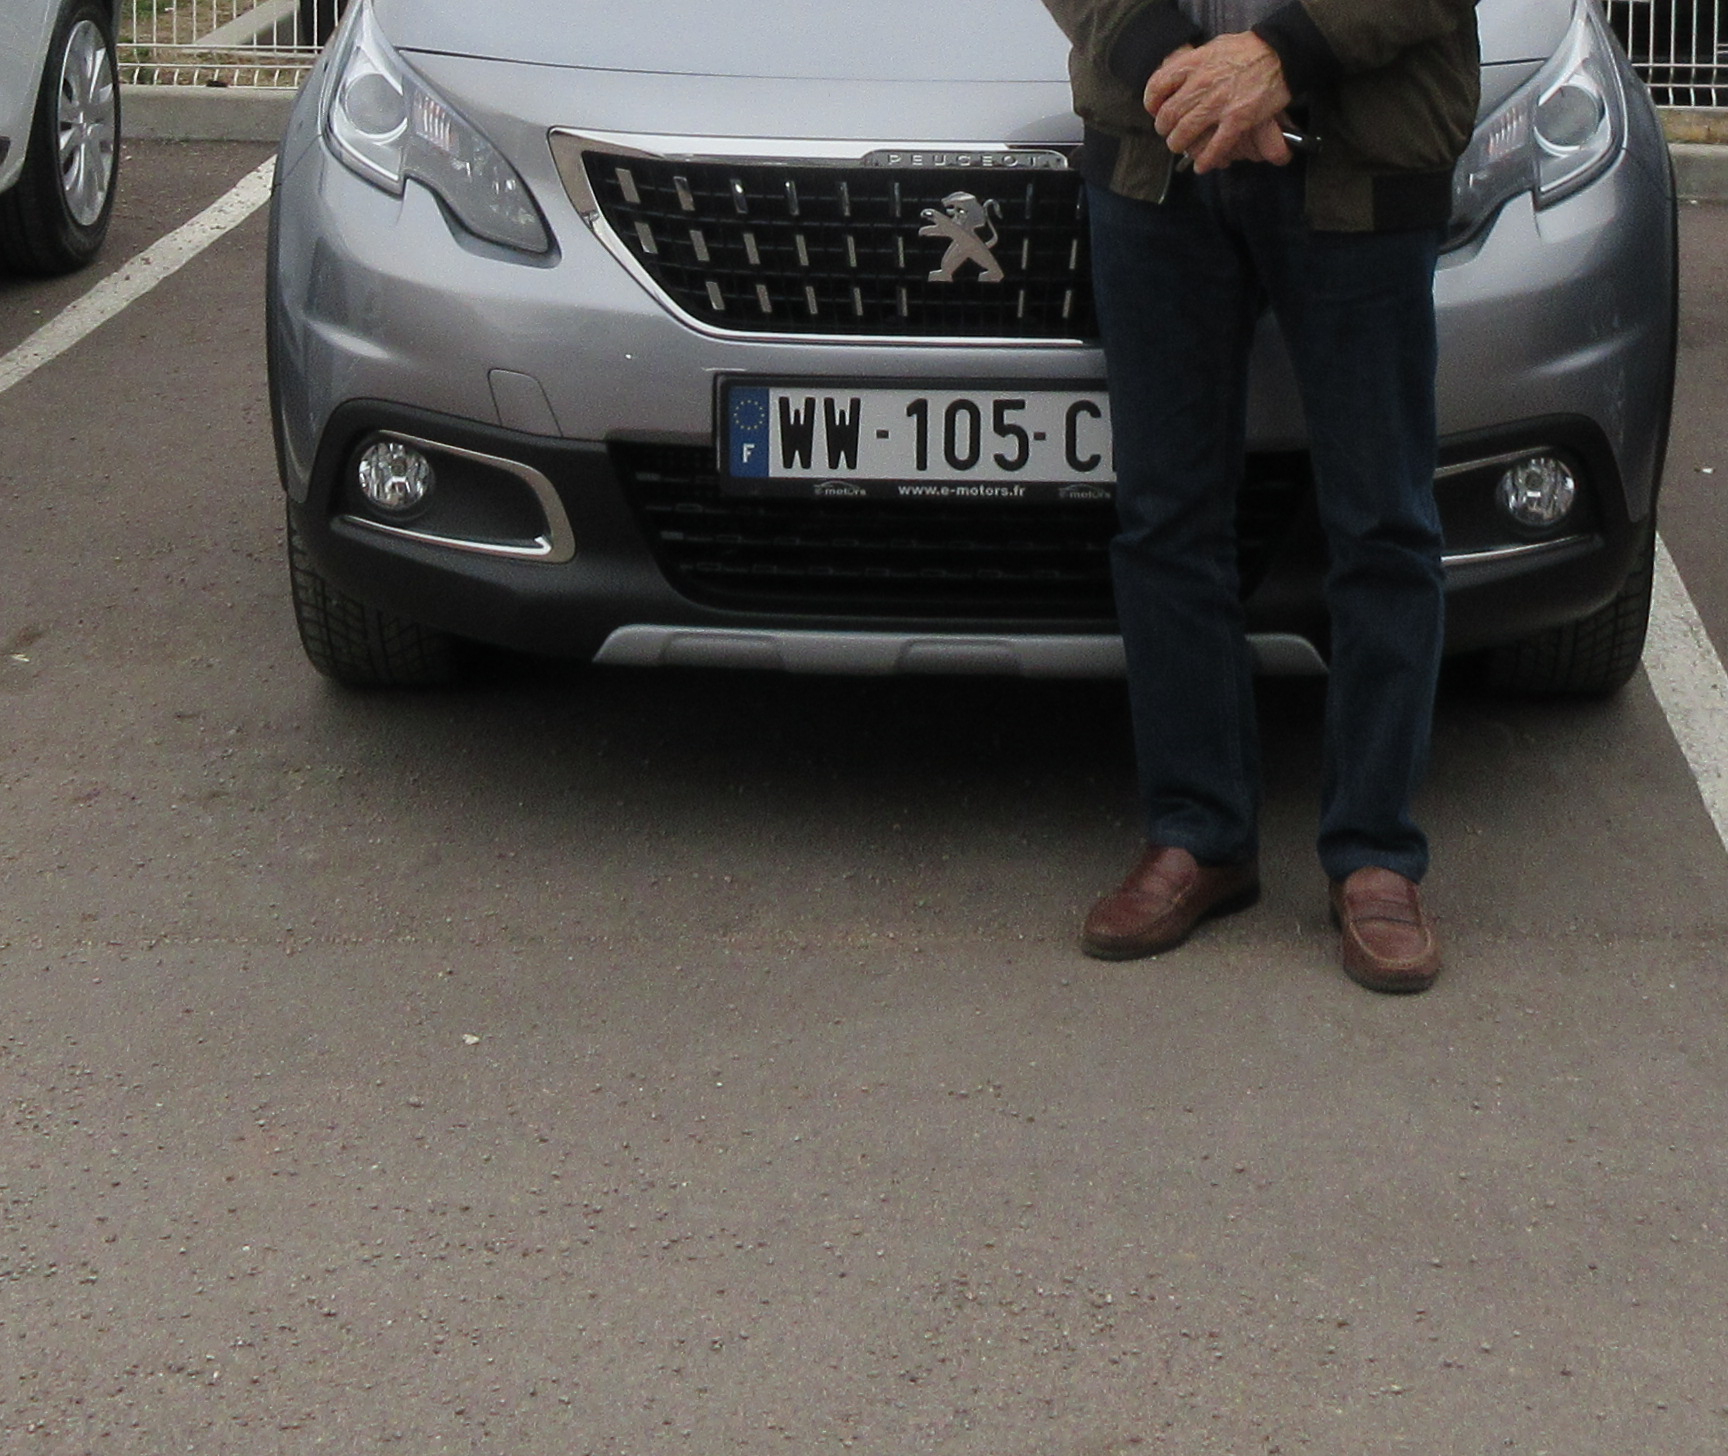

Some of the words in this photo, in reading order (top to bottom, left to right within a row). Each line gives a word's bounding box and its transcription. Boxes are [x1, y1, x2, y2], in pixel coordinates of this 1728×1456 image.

[887, 153, 1042, 168] PEUGEOT
[742, 443, 755, 464] F
[778, 396, 1117, 473] WW-105-C
[897, 483, 1027, 498] www.e-motors.fr
